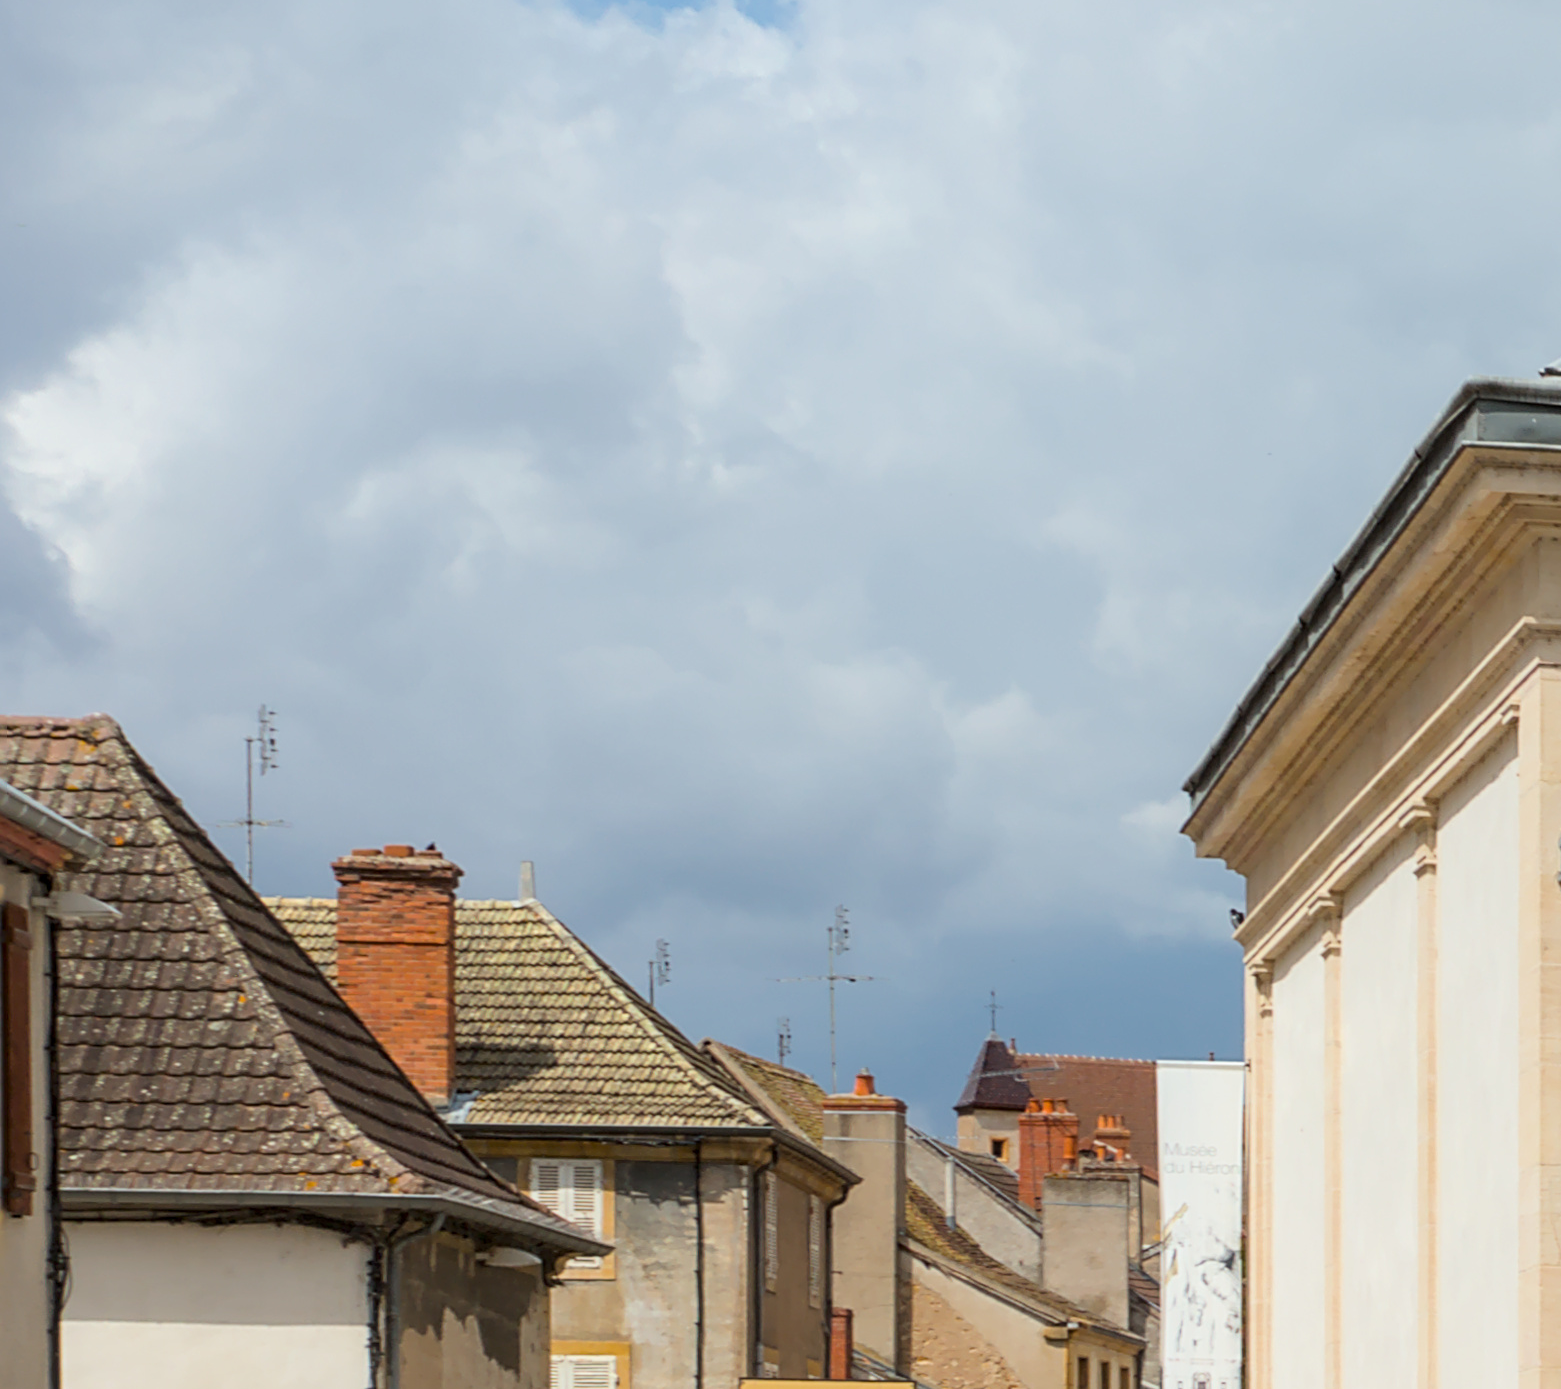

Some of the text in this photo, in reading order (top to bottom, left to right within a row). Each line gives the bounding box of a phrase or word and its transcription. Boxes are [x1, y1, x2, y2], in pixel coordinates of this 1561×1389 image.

[1164, 1142, 1217, 1156] Musée
[1164, 1160, 1240, 1175] du Hiéron
